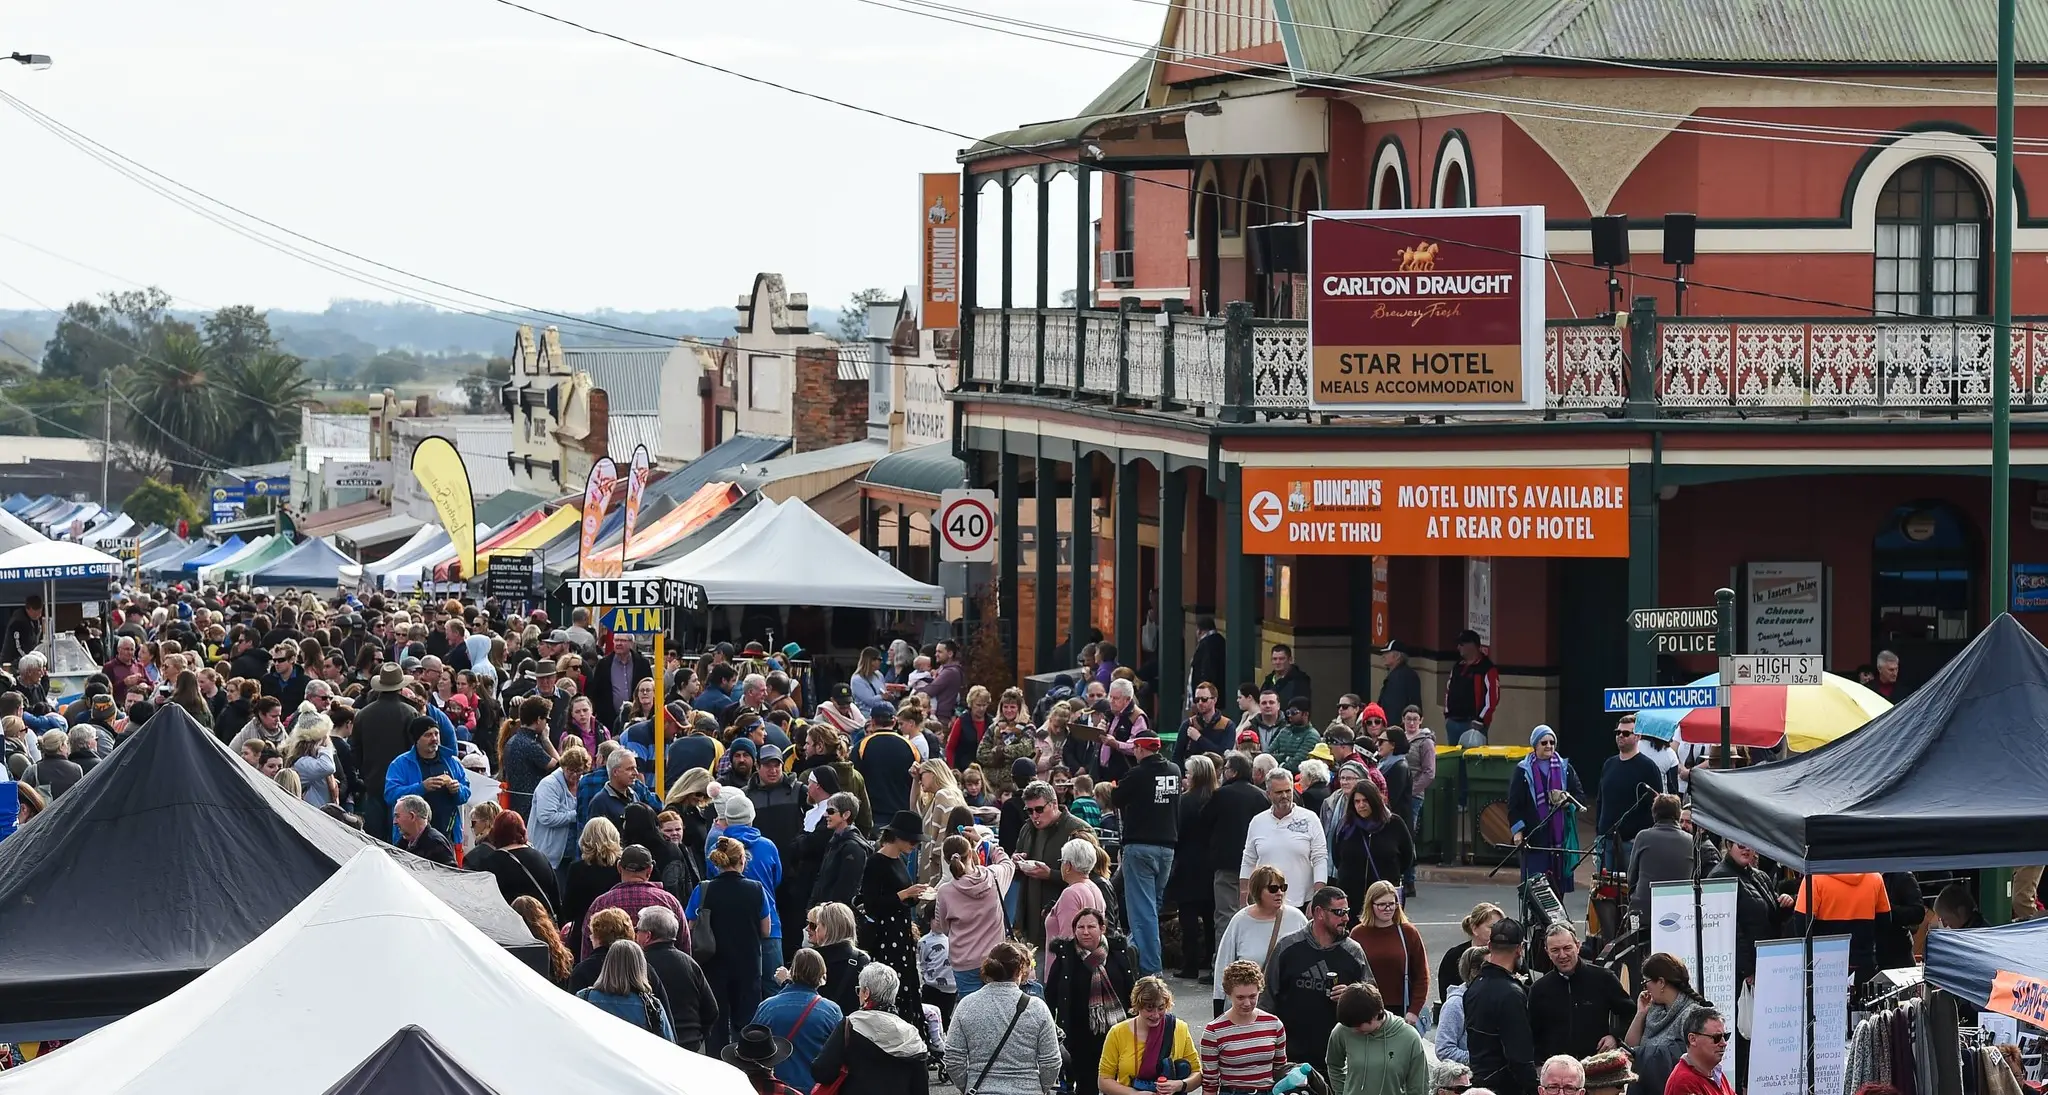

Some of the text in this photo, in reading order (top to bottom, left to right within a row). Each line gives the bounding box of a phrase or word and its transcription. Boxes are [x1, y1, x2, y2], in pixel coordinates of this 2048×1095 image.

[932, 228, 956, 302] DUNCAN'S
[1323, 275, 1512, 296] CARLTON DRAUGHT
[1370, 302, 1461, 327] Brewery Fresh
[1340, 353, 1494, 375] STAR HOTEL
[1320, 380, 1514, 394] MEALS ACCOMMODATION
[1313, 480, 1381, 506] DUNCAN'S
[1398, 486, 1624, 510] MOTEL UNITS AVAILABLE
[949, 514, 984, 537] 40
[1289, 522, 1381, 542] DRIVE THRU
[1426, 516, 1594, 539] AT REAR OF HOTEL
[100, 539, 136, 548] TOILETS
[24, 566, 62, 578] MELTS
[66, 565, 85, 576] ICE
[567, 581, 660, 606] TOILETS
[664, 582, 698, 610] OFFICE
[1753, 580, 1817, 603] The Eastern Palace
[613, 608, 661, 632] ATM
[1634, 609, 1718, 629] SHOWGROUNDS
[1756, 617, 1814, 625] Restaurant
[1765, 607, 1804, 615] Chinese
[1658, 635, 1716, 652] POLICE
[1758, 628, 1794, 641] Dancing and
[1778, 637, 1803, 647] Drinking
[1756, 658, 1791, 674] HIGH
[1754, 675, 1780, 683] 129-75
[1791, 675, 1818, 683] 136-78
[1609, 689, 1712, 708] ANGLICAN CHURCH
[1155, 776, 1176, 790] 30
[1296, 978, 1326, 991] adid
